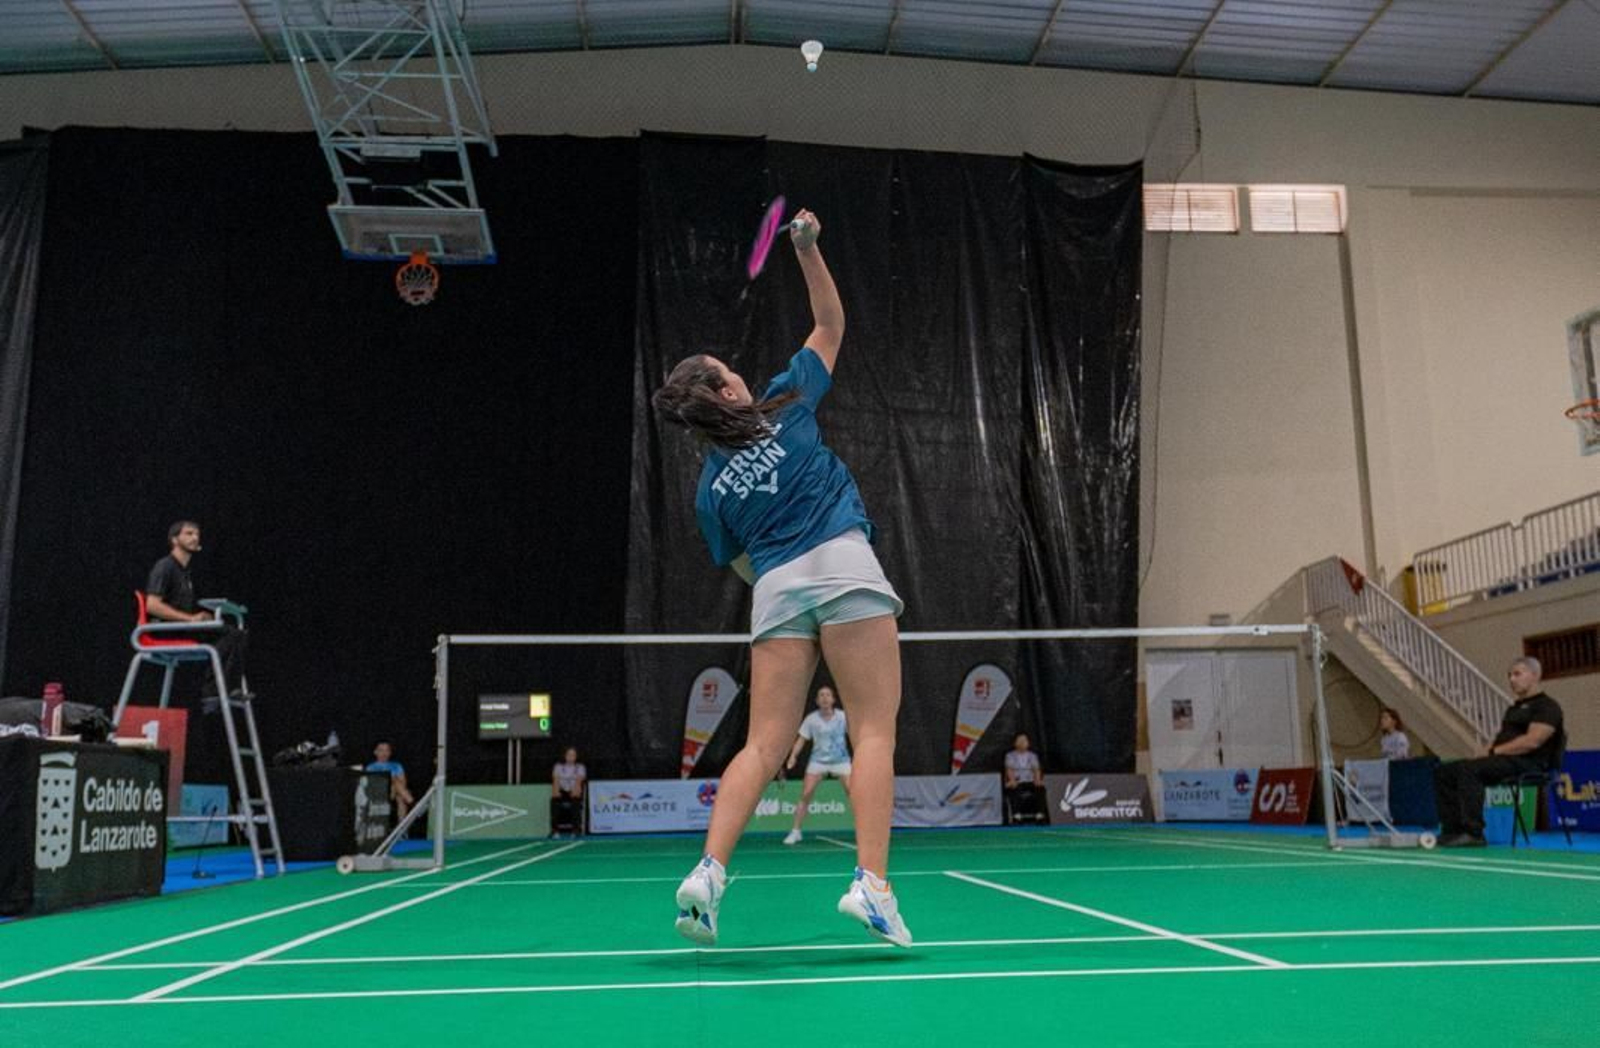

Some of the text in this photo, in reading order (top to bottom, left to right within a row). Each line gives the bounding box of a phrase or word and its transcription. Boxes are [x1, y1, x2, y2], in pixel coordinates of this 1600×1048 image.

[732, 441, 787, 499] SPAIN
[142, 720, 159, 748] 1
[83, 777, 163, 812] Cabildo de
[594, 801, 677, 813] LANZAROTE
[80, 820, 157, 853] Lanzarote
